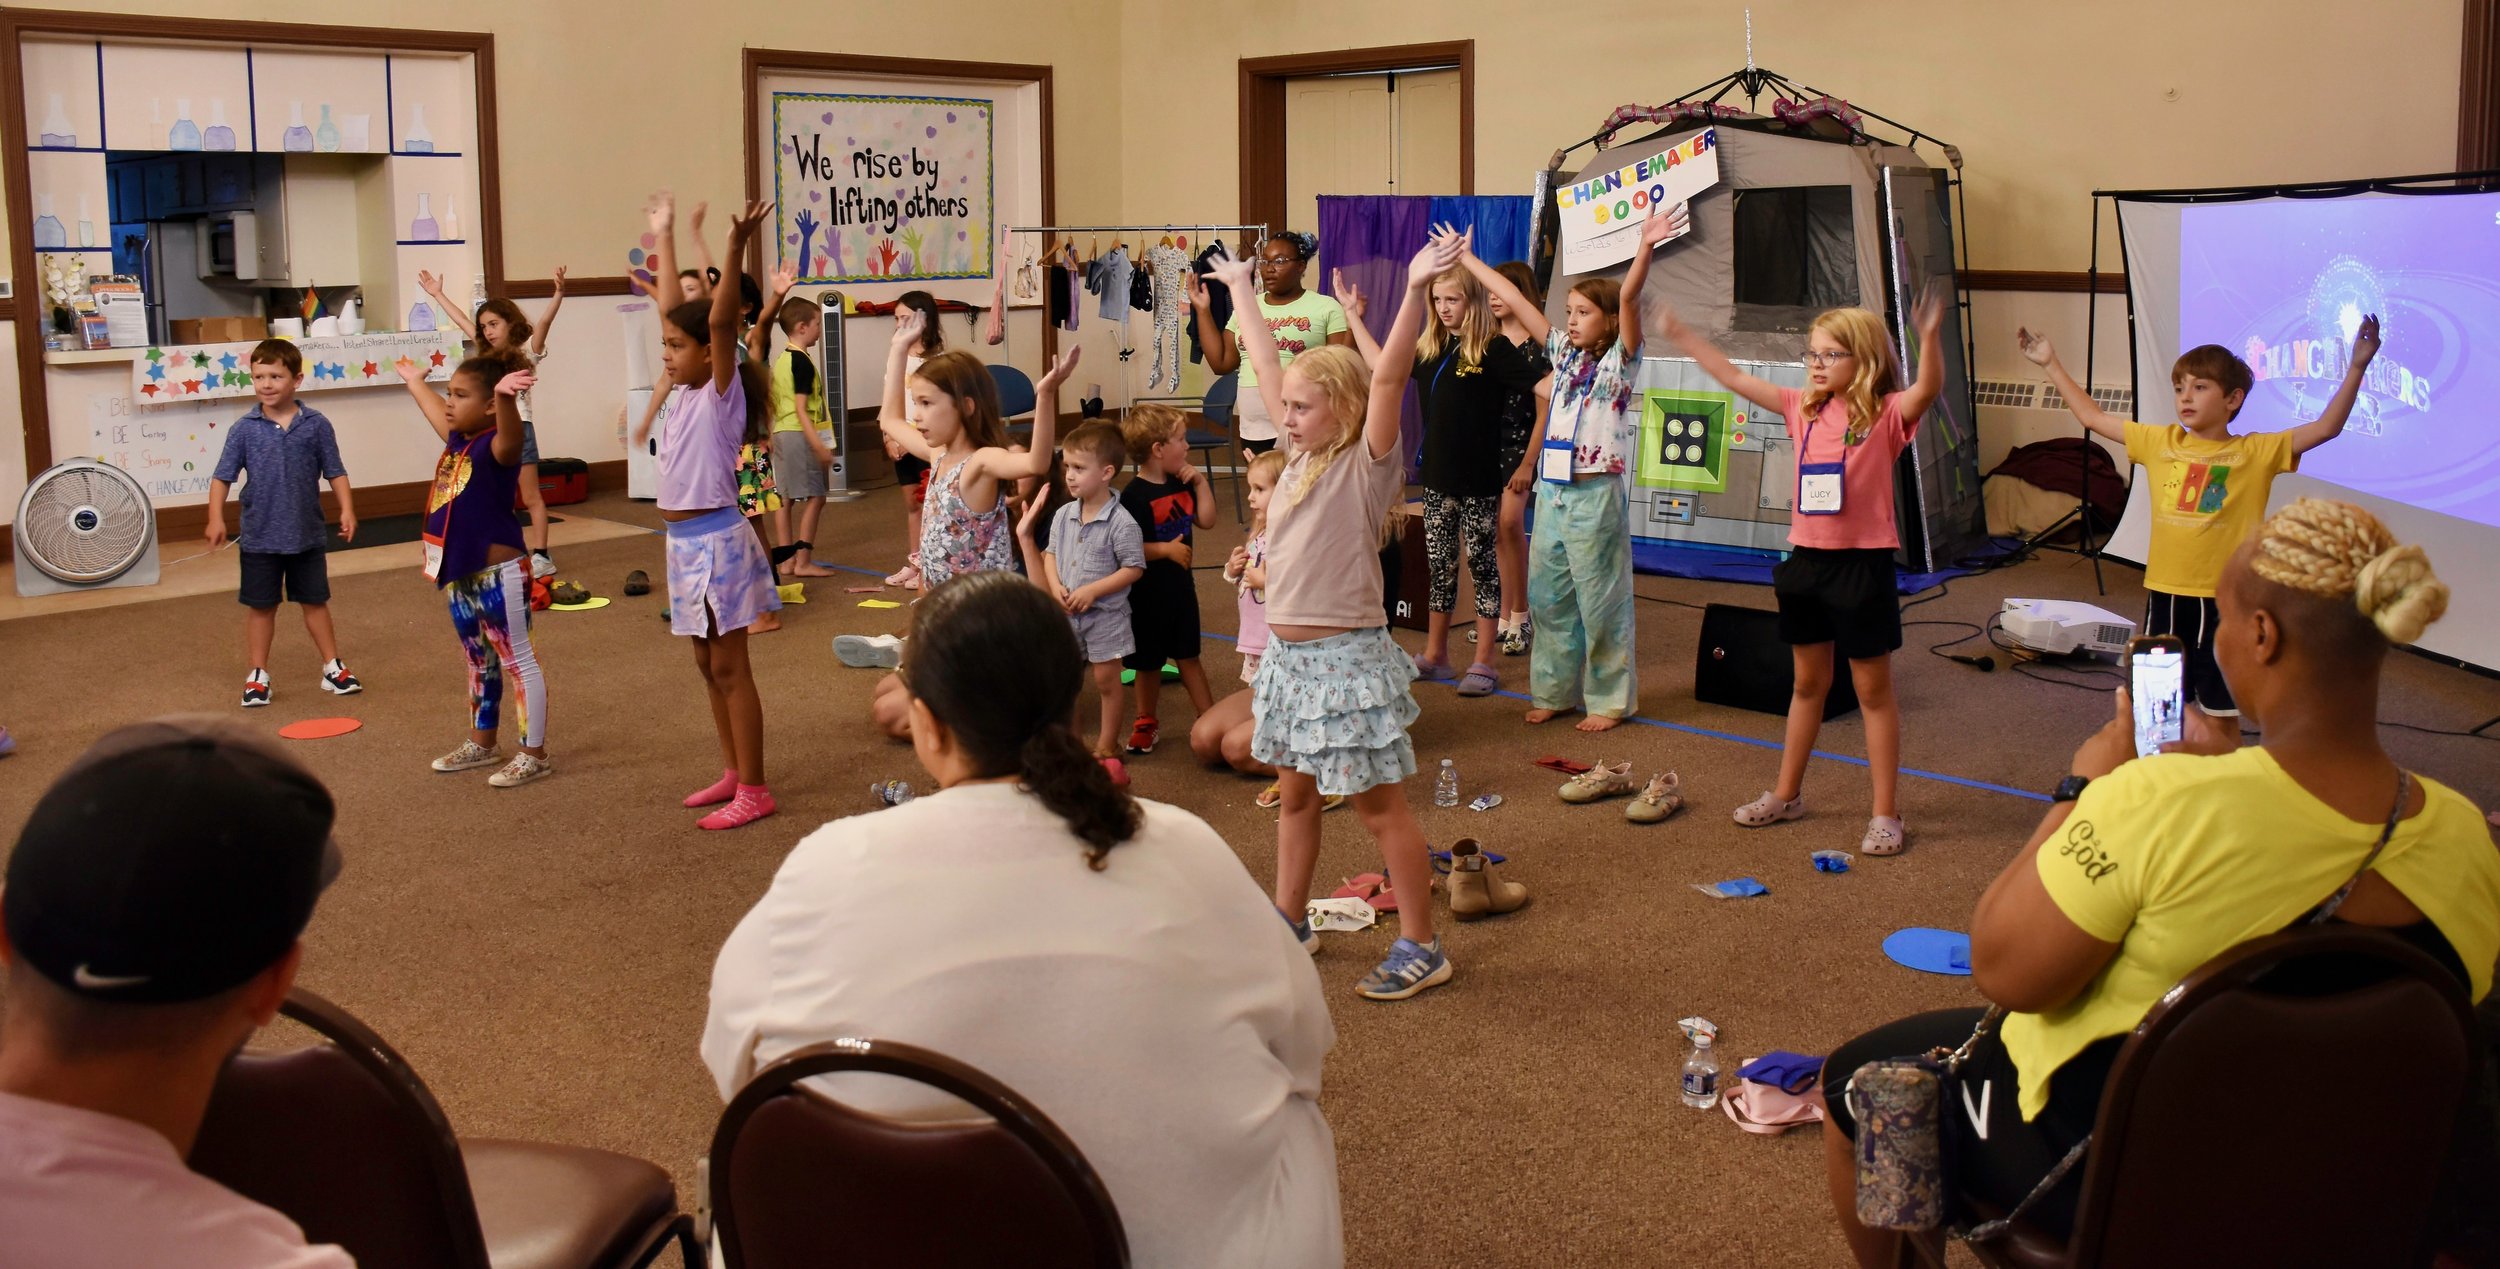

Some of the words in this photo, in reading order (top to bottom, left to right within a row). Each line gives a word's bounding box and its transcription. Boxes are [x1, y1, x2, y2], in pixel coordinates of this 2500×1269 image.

[791, 133, 834, 182] We
[853, 147, 902, 179] rise
[912, 147, 939, 190] by
[1556, 129, 1716, 209] CHANGEMAKER
[830, 186, 898, 234] lifting
[904, 186, 968, 219] others
[2247, 337, 2431, 413] CHANGEMKERS
[112, 425, 129, 444] BE
[2292, 381, 2383, 437] LB
[1810, 490, 1831, 499] LUCY
[2060, 820, 2119, 886] God
